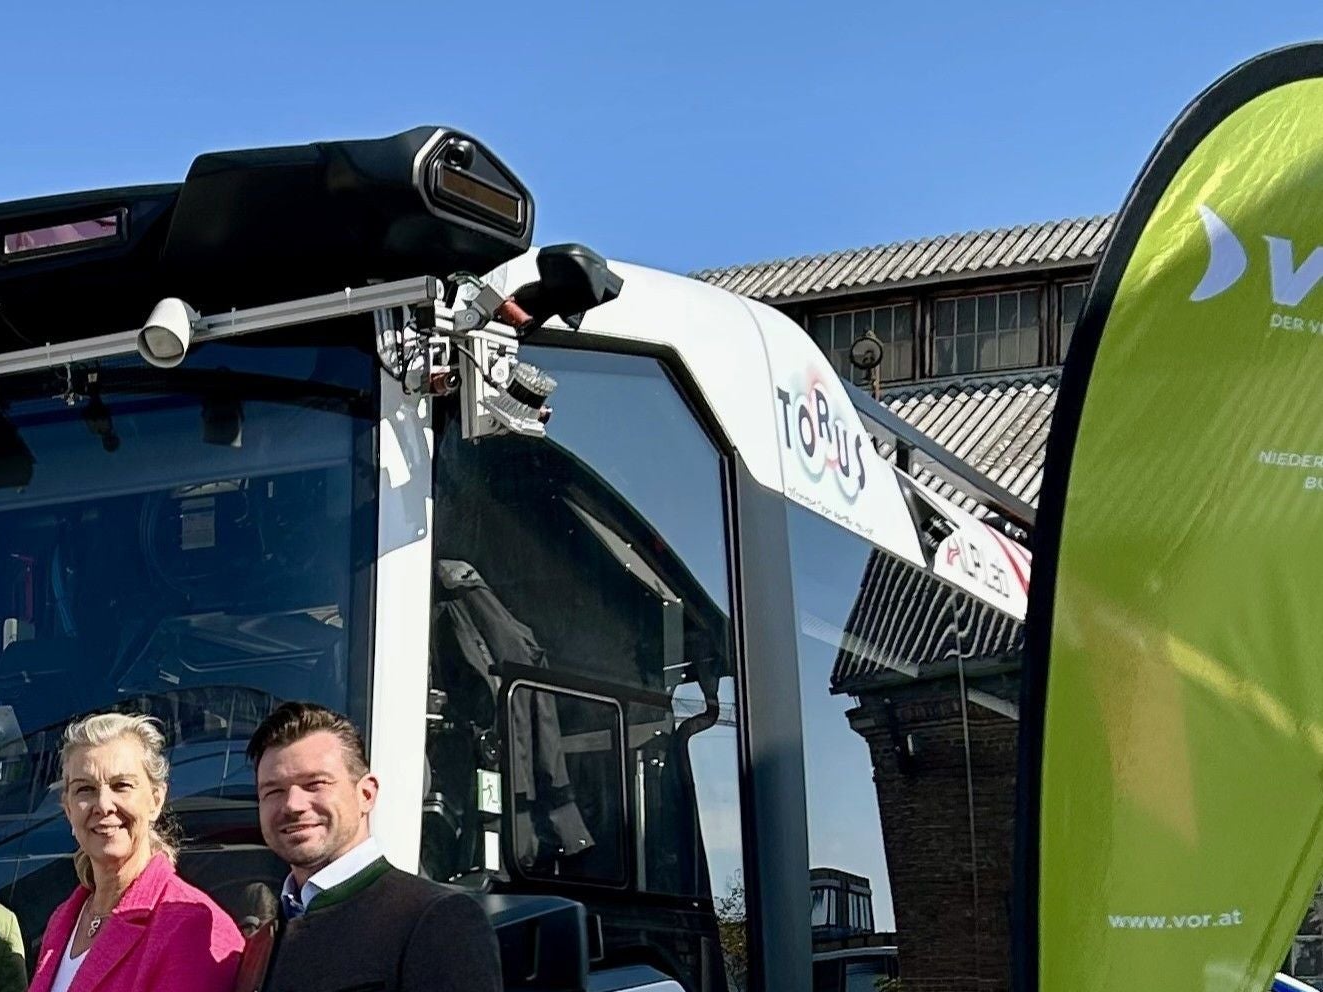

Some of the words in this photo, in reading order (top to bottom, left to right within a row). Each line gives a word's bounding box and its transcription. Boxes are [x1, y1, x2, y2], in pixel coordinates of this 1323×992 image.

[1270, 313, 1304, 331] DER
[776, 385, 865, 490] TORUS
[1108, 908, 1244, 929] www.vor.at
